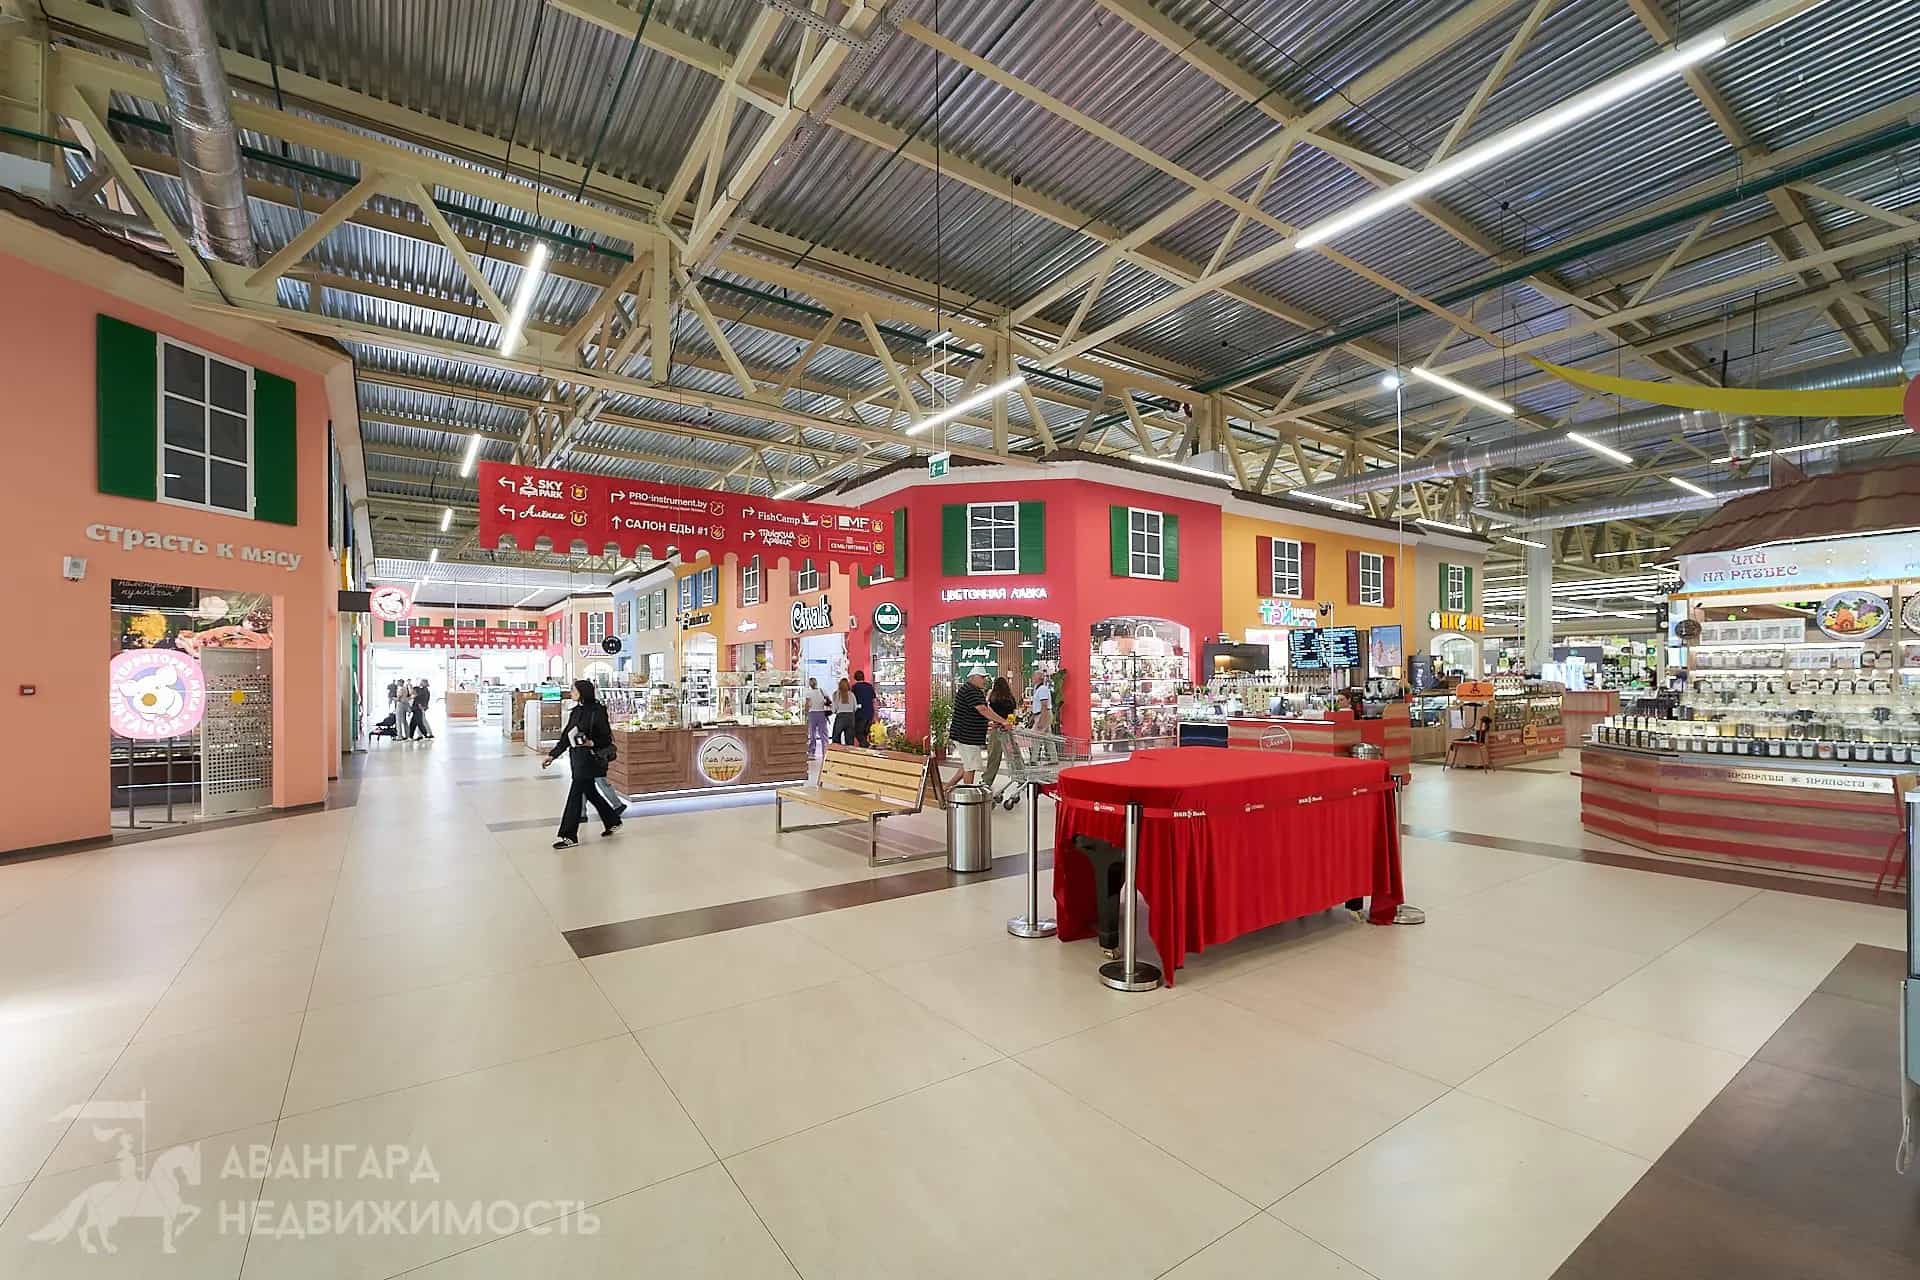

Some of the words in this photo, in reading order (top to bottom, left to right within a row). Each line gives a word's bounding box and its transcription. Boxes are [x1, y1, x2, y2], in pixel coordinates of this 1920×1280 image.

[538, 479, 564, 491] SKY
[538, 489, 564, 499] PARK
[629, 491, 708, 509] PRO-instrument.by
[757, 511, 801, 526] FishCamp
[625, 518, 667, 532] САЛОН
[669, 523, 695, 536] ЕДЫ
[697, 527, 709, 537] #1
[86, 524, 209, 554] страсть
[216, 543, 235, 558] к
[241, 546, 302, 571] мясу
[1731, 551, 1767, 566] ЧАЙ
[1703, 571, 1725, 583] НА
[1731, 565, 1799, 581] РАЗВЕС
